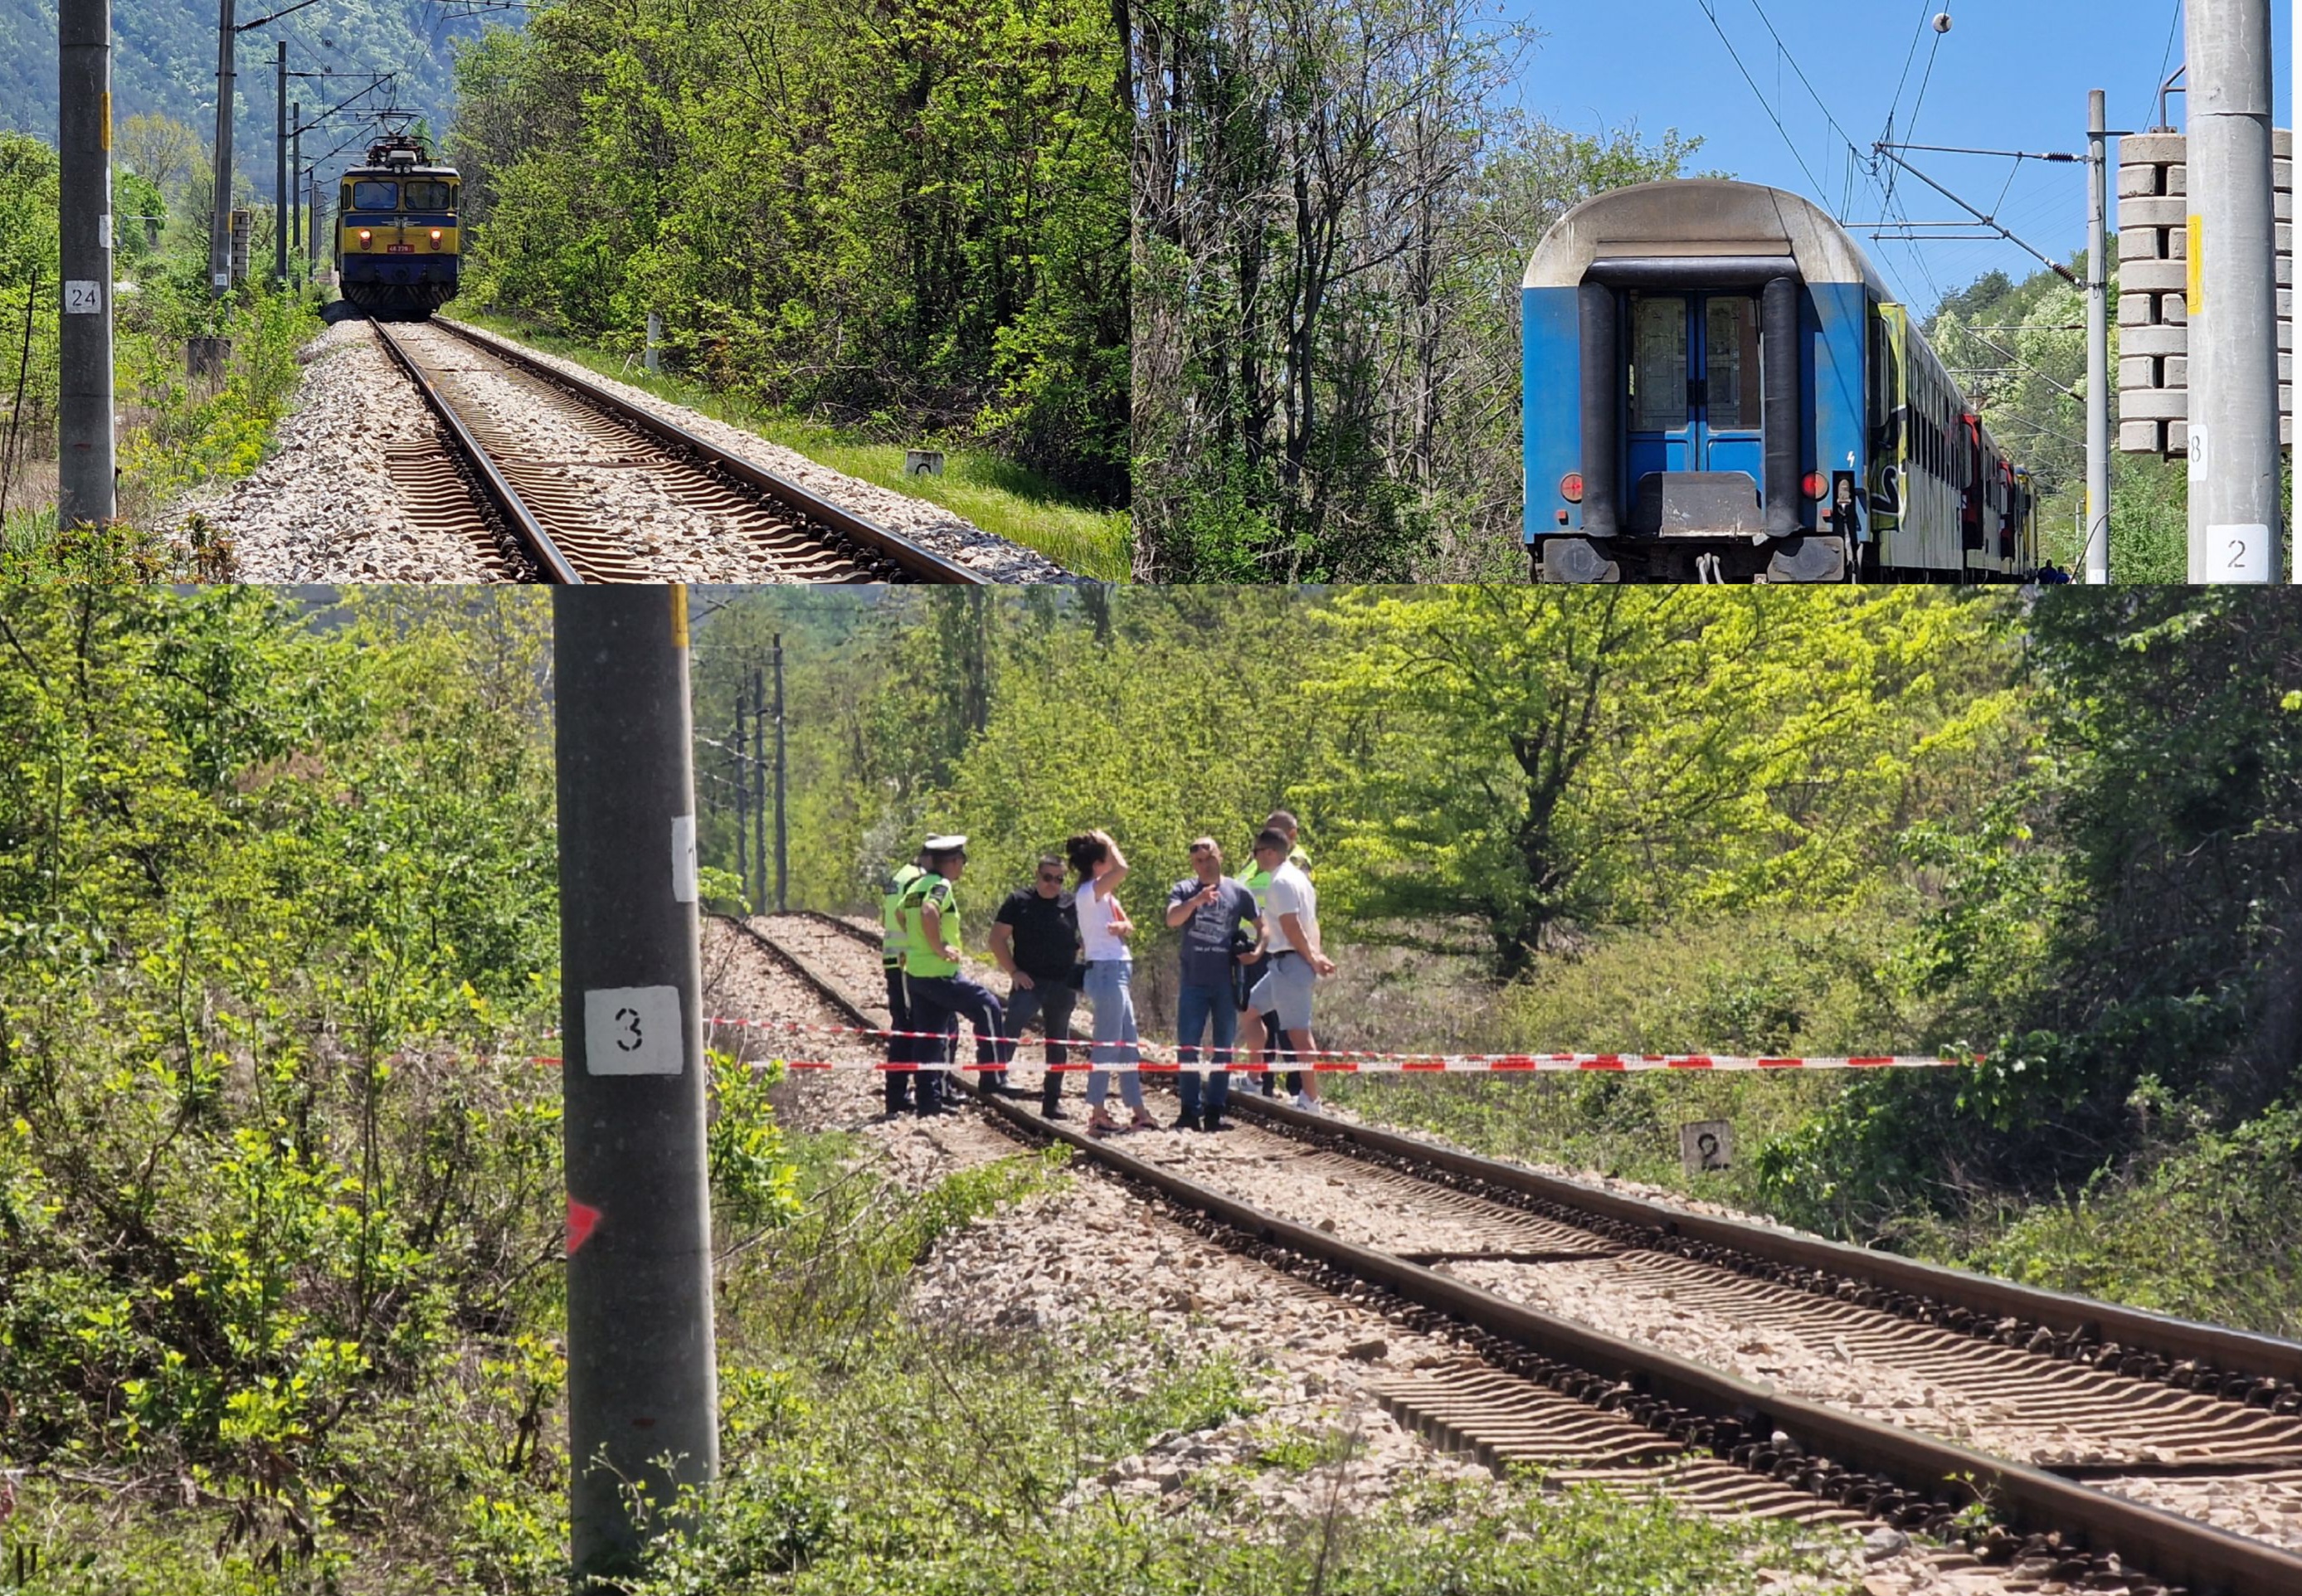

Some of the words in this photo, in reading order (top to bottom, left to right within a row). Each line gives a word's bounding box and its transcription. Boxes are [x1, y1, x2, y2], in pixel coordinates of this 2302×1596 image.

[72, 289, 96, 307] 24
[2227, 539, 2246, 568] 2
[615, 1007, 643, 1052] 3
